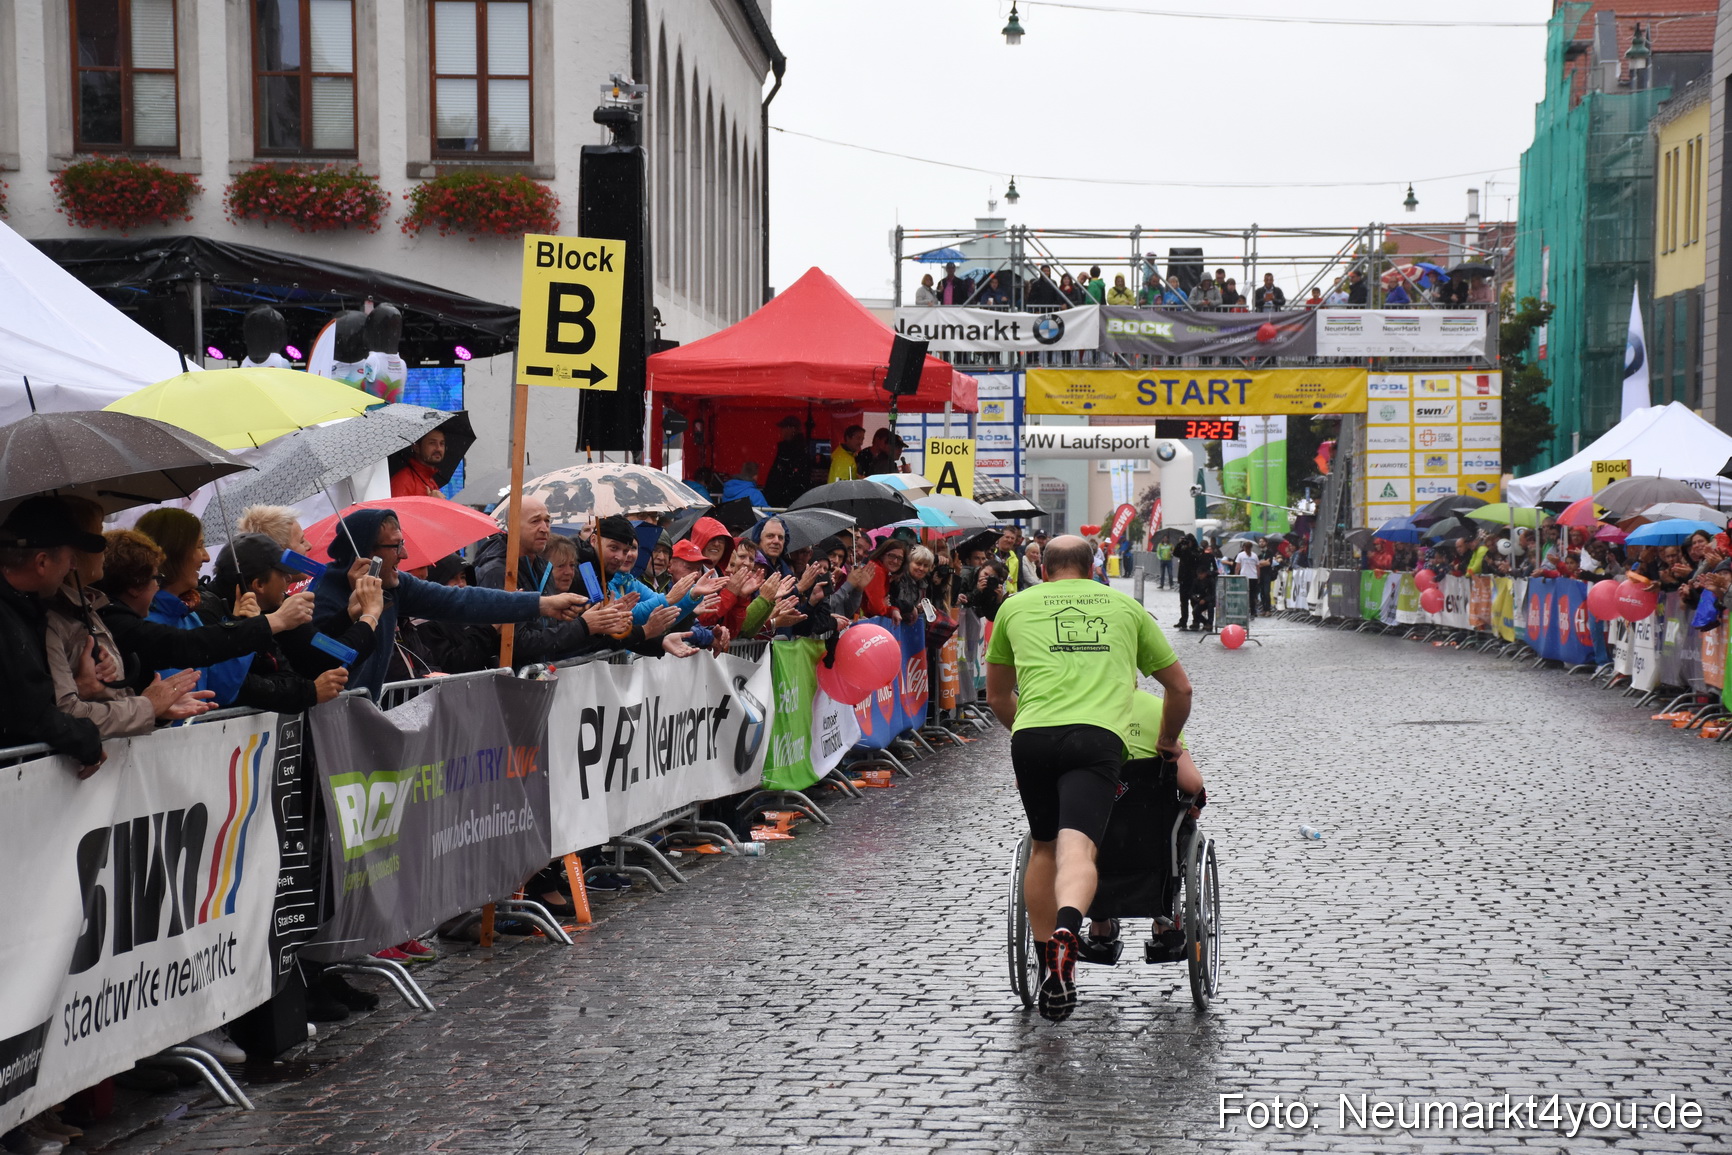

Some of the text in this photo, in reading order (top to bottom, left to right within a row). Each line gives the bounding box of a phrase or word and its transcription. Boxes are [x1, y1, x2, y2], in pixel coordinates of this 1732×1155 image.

[536, 241, 614, 273] Block
[545, 281, 597, 355] B
[1107, 319, 1173, 337] BOCK
[1136, 379, 1253, 406] START
[1416, 407, 1442, 415] swn
[1025, 434, 1149, 452] MW Laufsport
[1185, 420, 1234, 439] 32:25
[931, 441, 969, 455] Block
[936, 461, 962, 497] A
[1596, 462, 1628, 473] Block
[1113, 507, 1133, 538] REWE
[855, 634, 887, 657] RÖDL
[646, 690, 731, 780] Neumarkt
[69, 802, 208, 975] swn
[64, 931, 237, 1046] stadtwrke neumarkt
